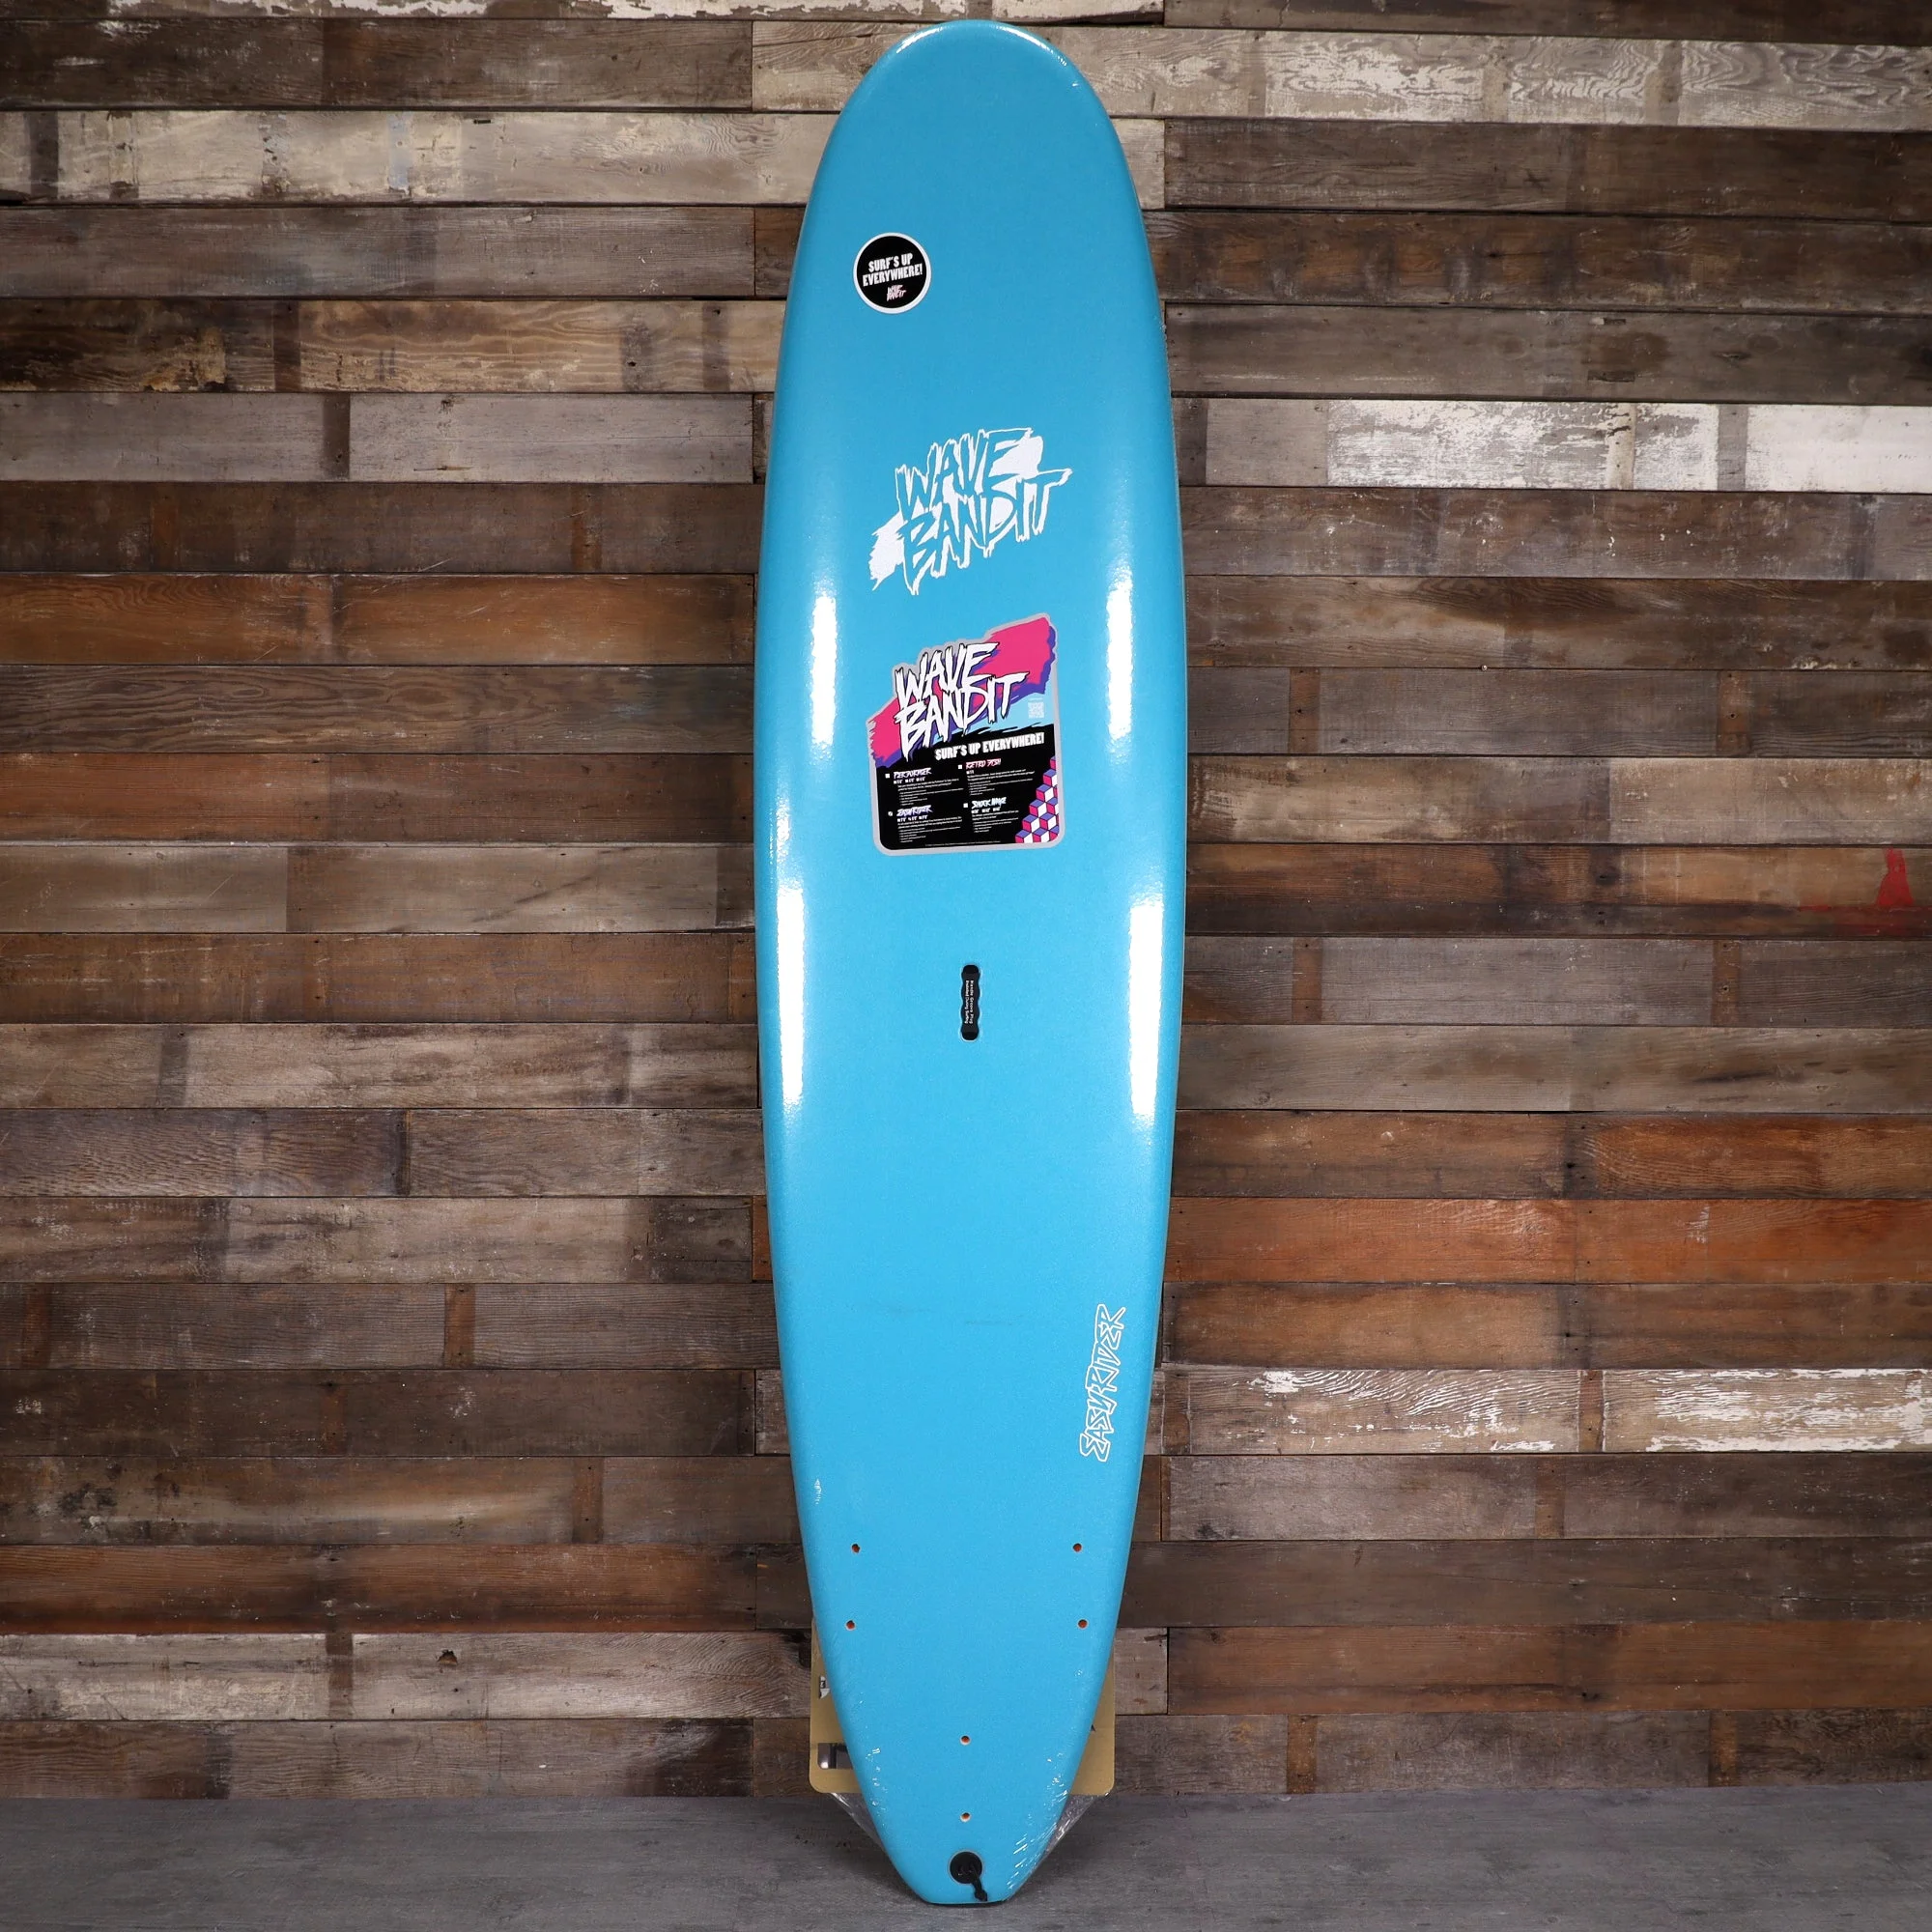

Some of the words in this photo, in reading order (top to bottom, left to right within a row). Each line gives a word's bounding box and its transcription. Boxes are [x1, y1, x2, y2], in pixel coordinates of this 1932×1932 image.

[863, 263, 923, 287] EVERYWHERE!
[868, 256, 899, 272] SURF'S
[901, 252, 913, 266] UP
[895, 427, 1033, 521] WAVE
[895, 468, 1072, 595] BANDIT
[895, 642, 1000, 703] WAVE
[894, 671, 1030, 762] BANDIT
[935, 745, 967, 760] SURF'S
[968, 742, 981, 754] UP
[981, 732, 1044, 753] EVERYWHERE!
